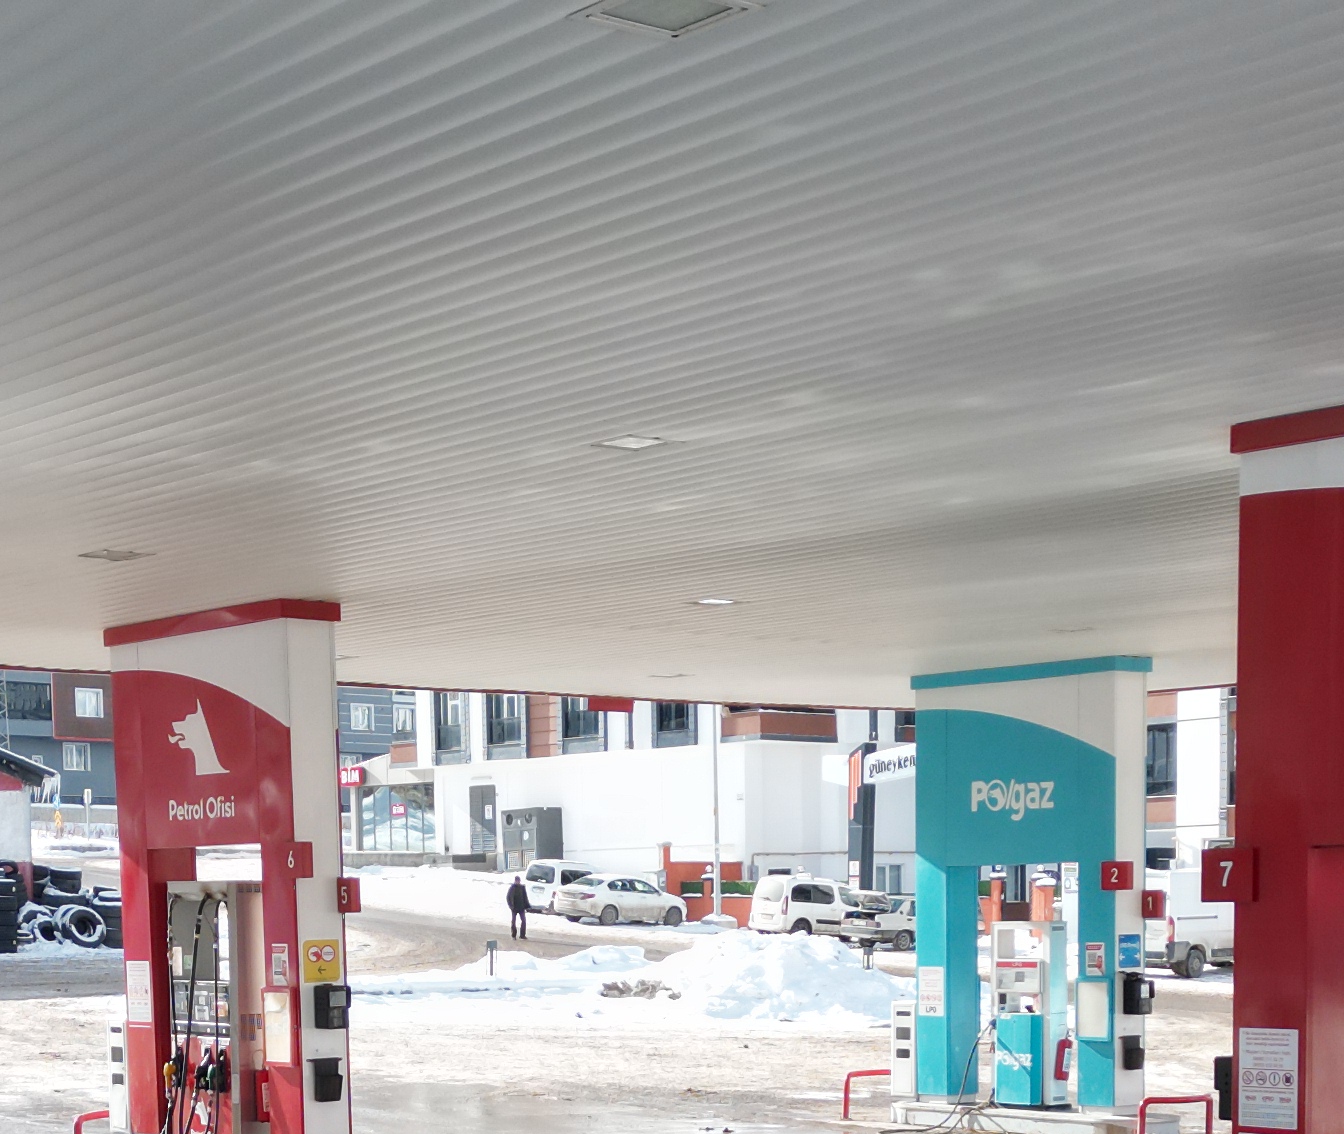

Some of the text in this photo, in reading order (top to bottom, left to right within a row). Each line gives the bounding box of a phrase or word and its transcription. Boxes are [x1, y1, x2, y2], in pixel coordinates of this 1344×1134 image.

[168, 795, 235, 821] Petrol Ofisi
[287, 850, 295, 869] 6
[1110, 867, 1119, 883] 2
[1219, 861, 1234, 887] 7
[340, 886, 348, 904] 5
[1147, 895, 1153, 911] 1
